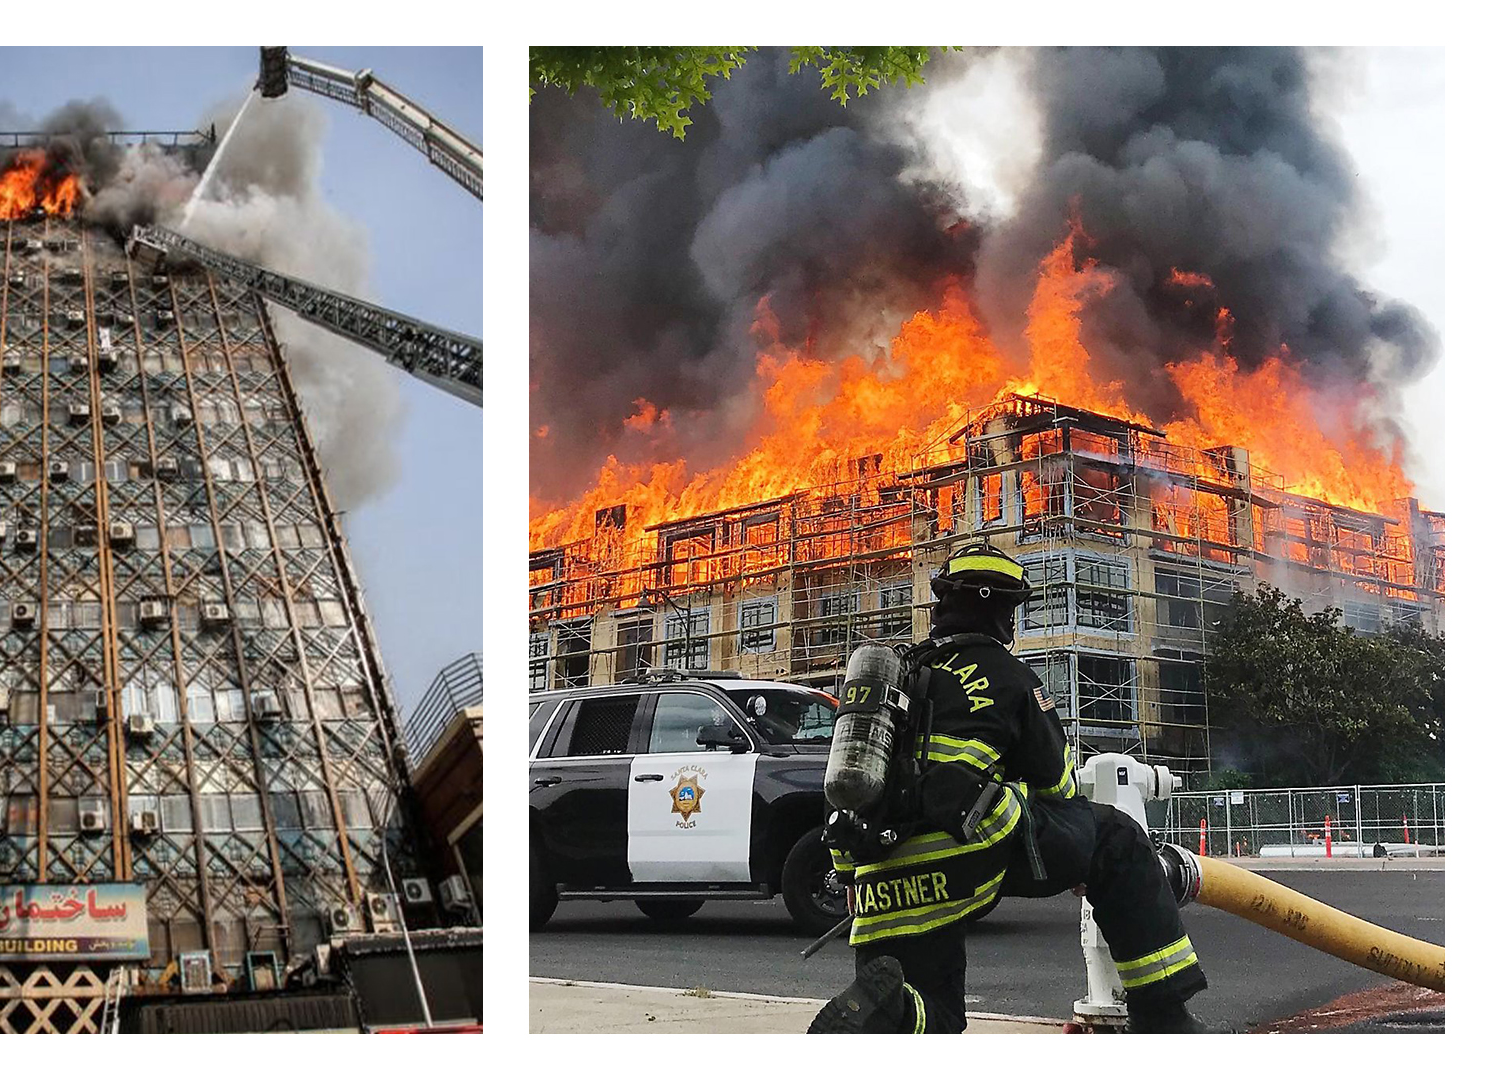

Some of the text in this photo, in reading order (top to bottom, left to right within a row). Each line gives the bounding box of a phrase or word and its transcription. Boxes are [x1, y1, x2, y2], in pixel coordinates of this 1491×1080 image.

[845, 686, 871, 705] 97
[671, 764, 709, 780] SANTA CLARA
[675, 820, 697, 829] POLICE
[854, 871, 949, 914] KASTNER
